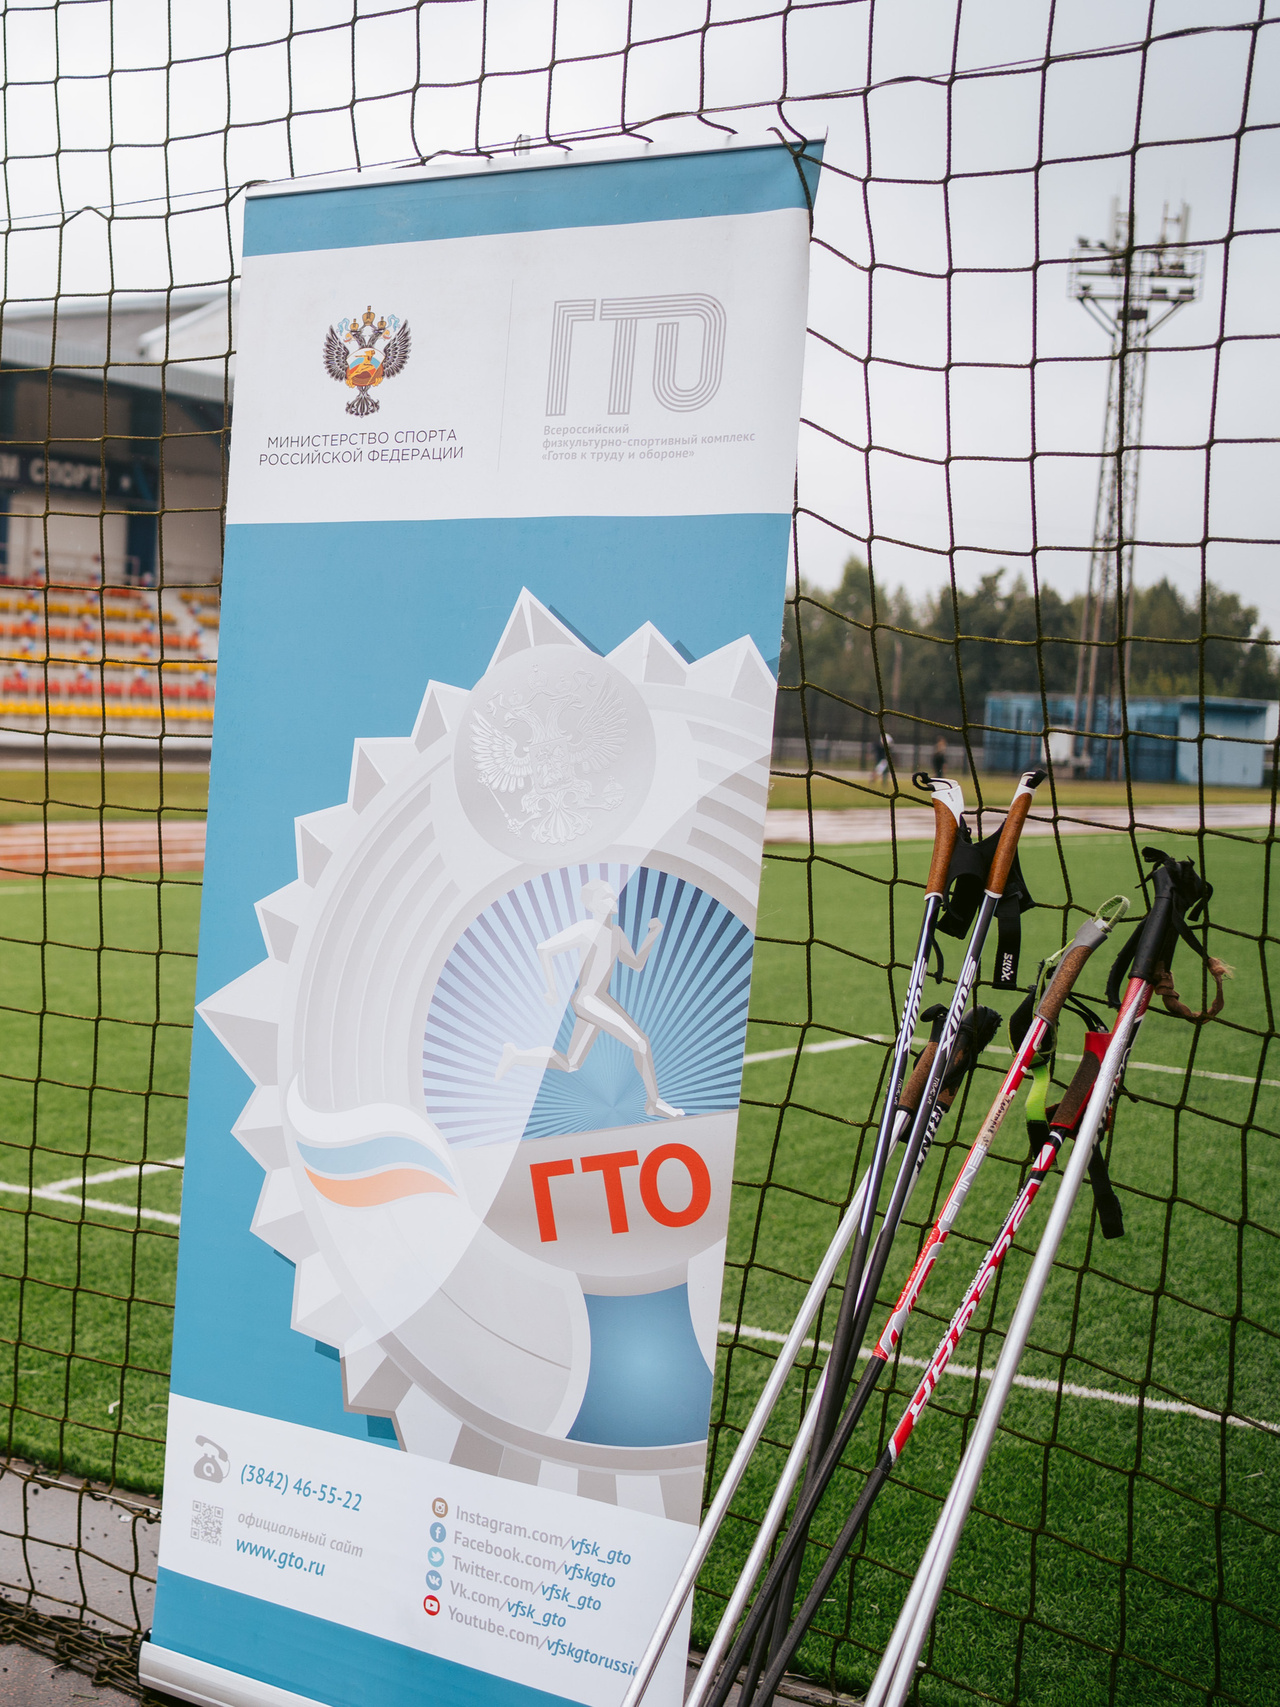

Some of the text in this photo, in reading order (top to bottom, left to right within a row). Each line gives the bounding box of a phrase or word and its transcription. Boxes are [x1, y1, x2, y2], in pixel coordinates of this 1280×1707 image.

[545, 292, 727, 417] ГТО
[267, 428, 457, 449] МИНИСТЕРСТВО СПОРТА
[542, 432, 756, 450] физкультурно-спортивный комплекс
[543, 424, 629, 437] Всероссийский
[259, 446, 464, 466] РОССИЙСКОЙ ФЕДЕРАЦИИ
[541, 448, 695, 462] «Готов к труду и обороне»
[529, 1143, 712, 1243] ГТО
[943, 1142, 989, 1223] ENIUS
[240, 1464, 363, 1511] (3842) 46-55-22
[236, 1538, 326, 1576] www.gto.ru
[237, 1512, 364, 1558] официальный сайт
[455, 1505, 632, 1565] Instagram.com/vfsk_gto
[453, 1530, 616, 1588] Facebook.com/vfskgto
[450, 1579, 567, 1628] Vk.com/vfsk_gto
[451, 1555, 602, 1611] Twitter.com/vfsk_gto
